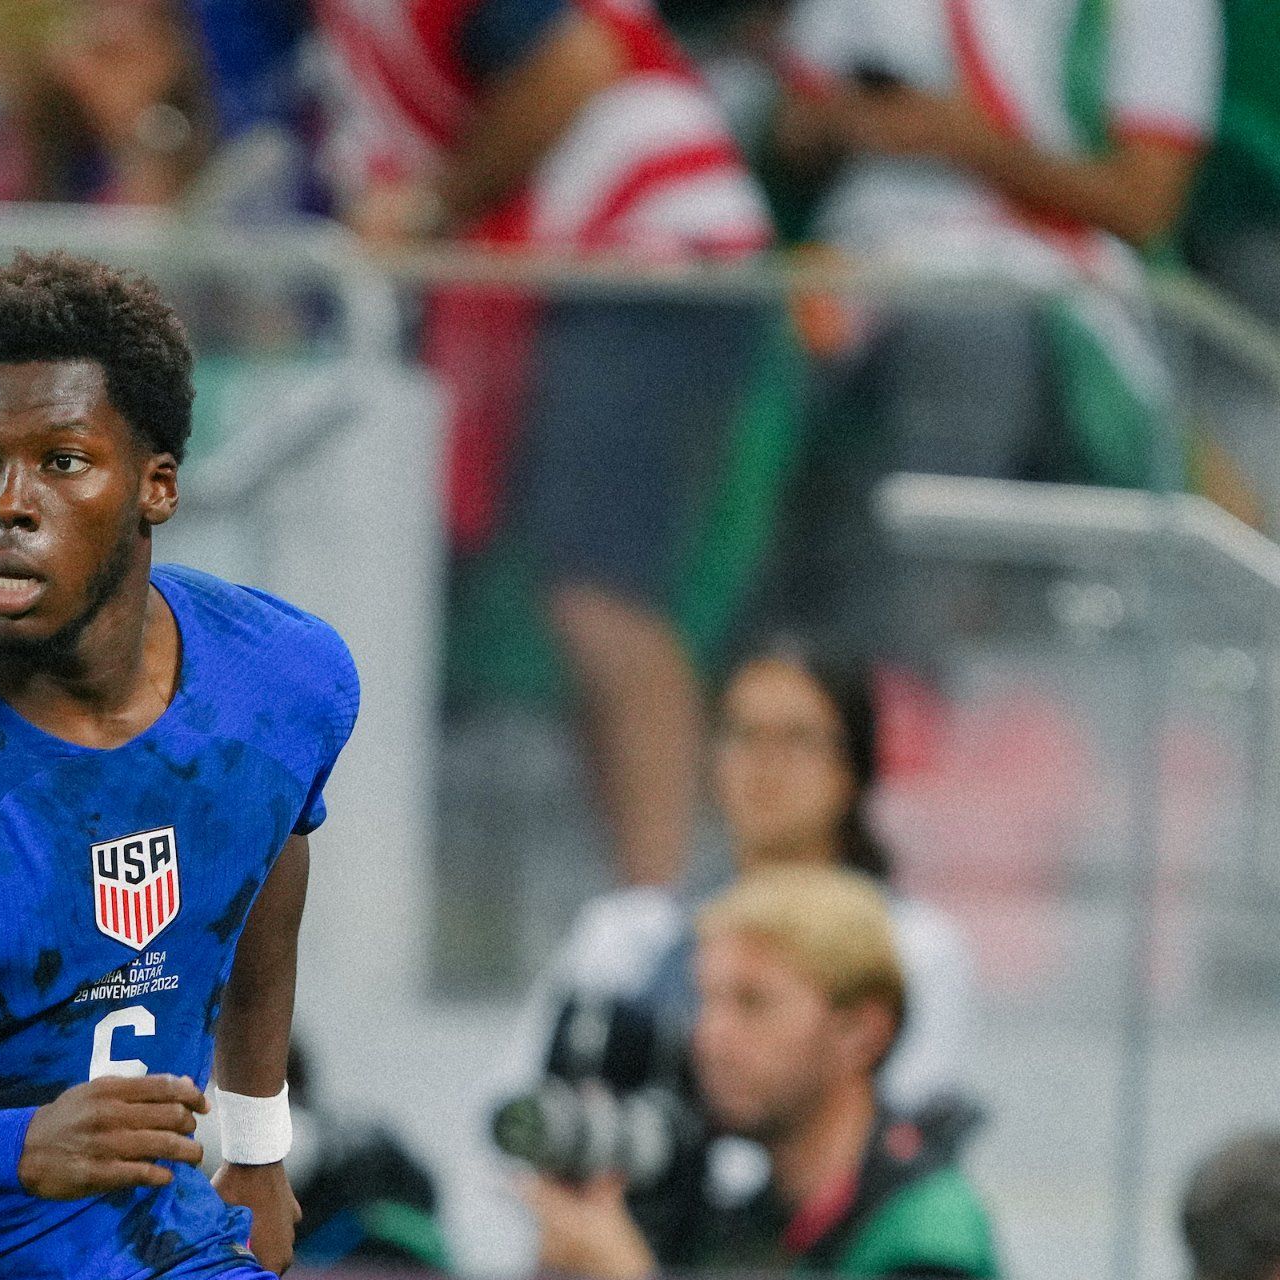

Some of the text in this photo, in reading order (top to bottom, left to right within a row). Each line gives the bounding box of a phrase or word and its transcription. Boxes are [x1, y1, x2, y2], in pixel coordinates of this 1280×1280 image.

[97, 834, 170, 885] USA
[145, 951, 167, 966] USA
[129, 965, 163, 983] QATAR
[74, 975, 179, 1003] 29 NOVEMBER 2022
